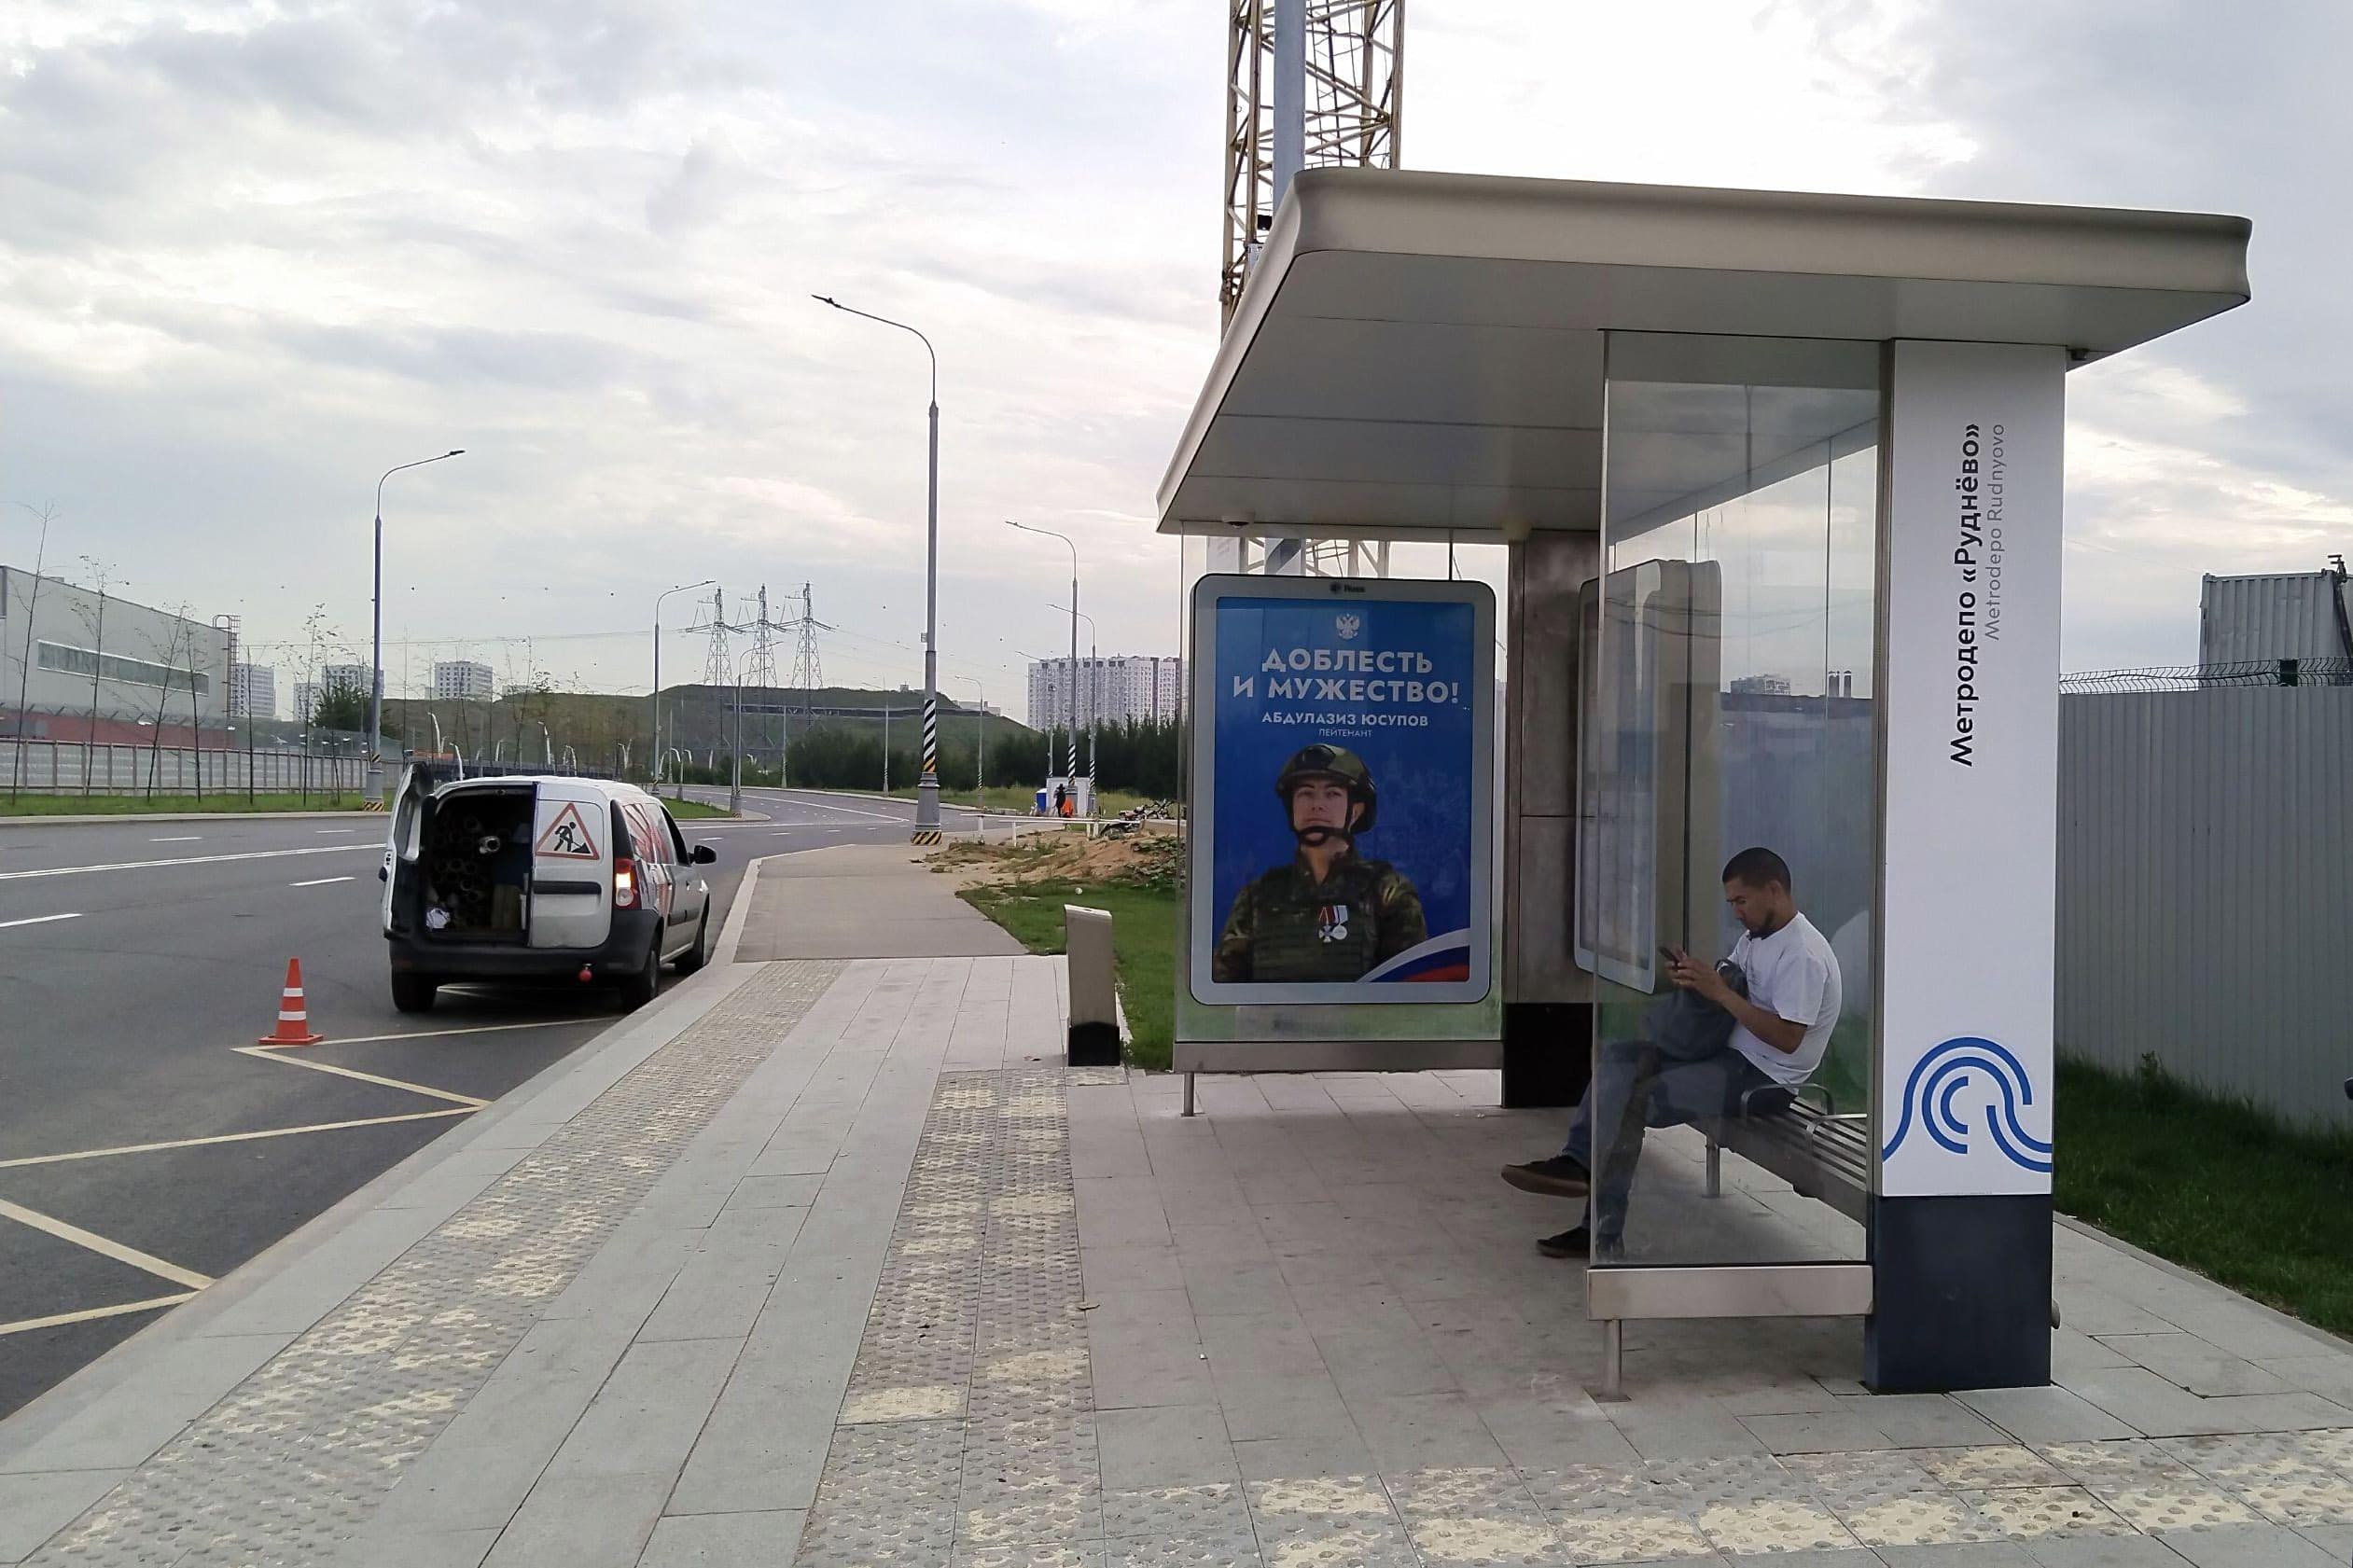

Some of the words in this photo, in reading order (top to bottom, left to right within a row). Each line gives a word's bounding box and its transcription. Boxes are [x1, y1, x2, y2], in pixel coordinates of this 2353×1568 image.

[1954, 423, 1983, 583] «Руднёво»
[1986, 423, 2007, 522] Rudnyovo
[1984, 527, 2005, 641] Metrodepo
[1232, 675, 1254, 699] И
[1268, 676, 1459, 704] МУЖЕСТВО!
[1261, 647, 1434, 673] ДОБЛЕСТЬ
[1950, 591, 1979, 767] Метродепо
[1261, 712, 1357, 725] АБДУЛАЗИЗ
[1361, 714, 1429, 727] ЮСУПОВ
[1318, 728, 1372, 738] ЛЕЙТЕНАНТ
